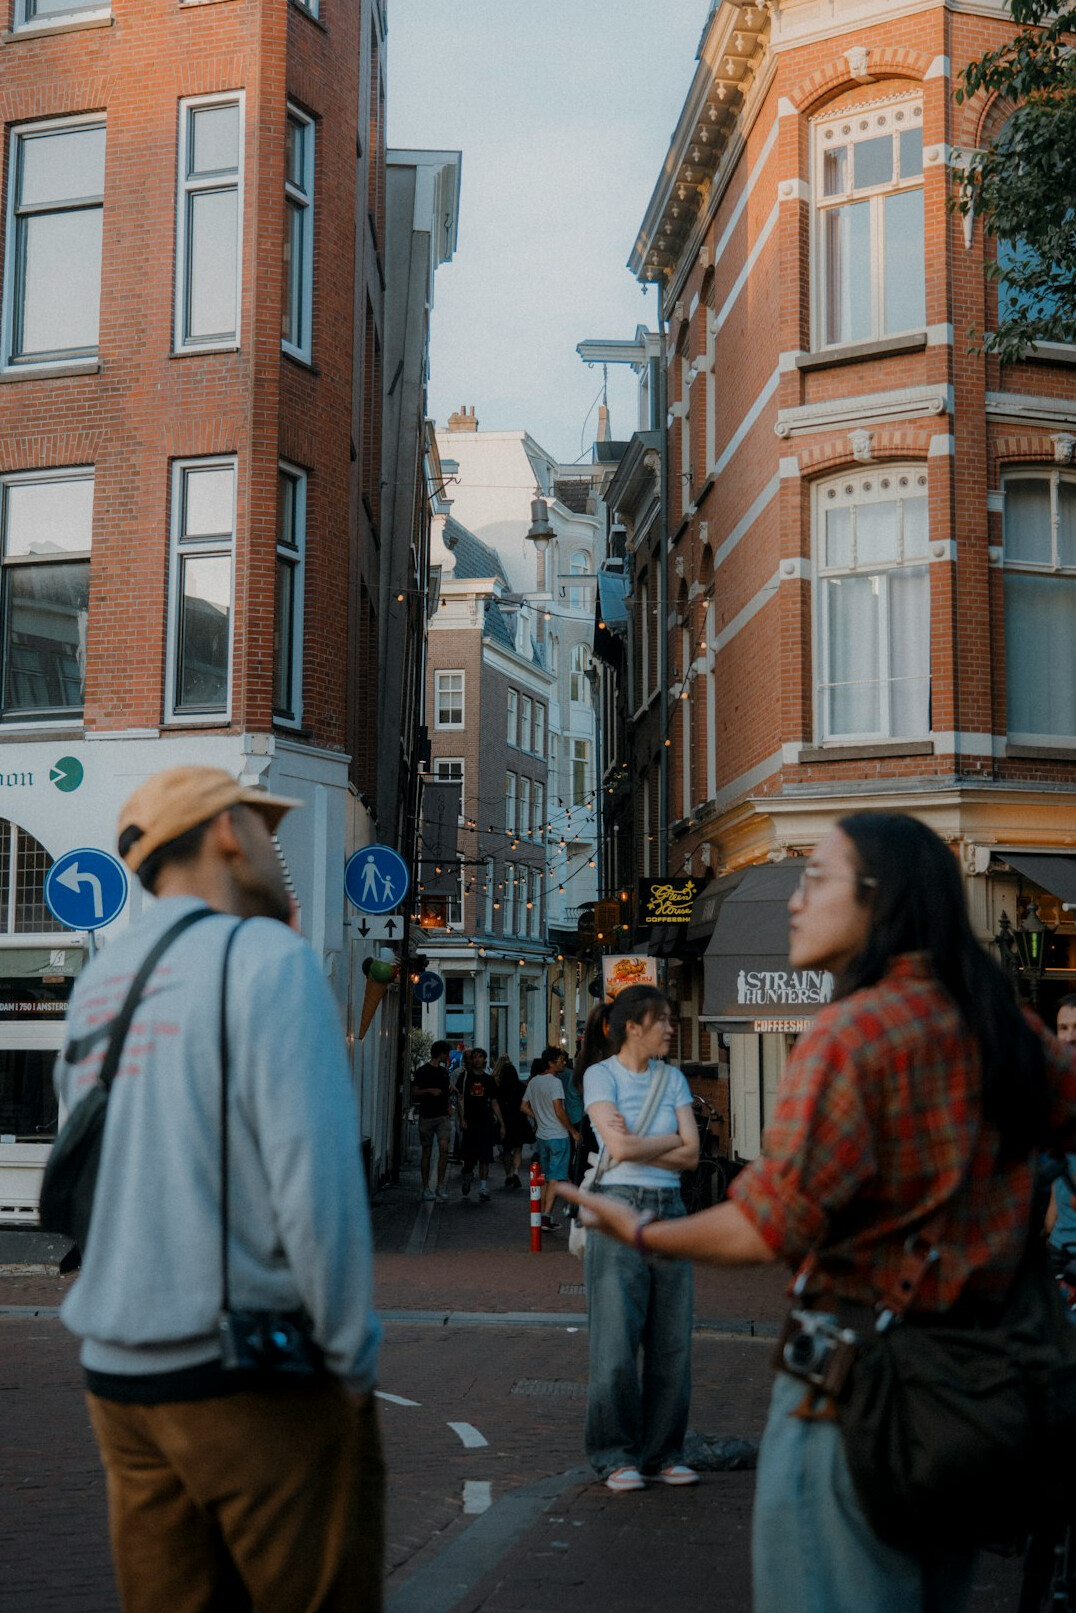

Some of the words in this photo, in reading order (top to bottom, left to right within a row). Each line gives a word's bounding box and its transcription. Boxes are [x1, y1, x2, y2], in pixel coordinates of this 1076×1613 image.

[651, 884, 692, 901] Green
[650, 899, 693, 915] House
[746, 970, 822, 990] STRAIN
[745, 989, 820, 1005] HUNTERS
[19, 1002, 32, 1011] 750
